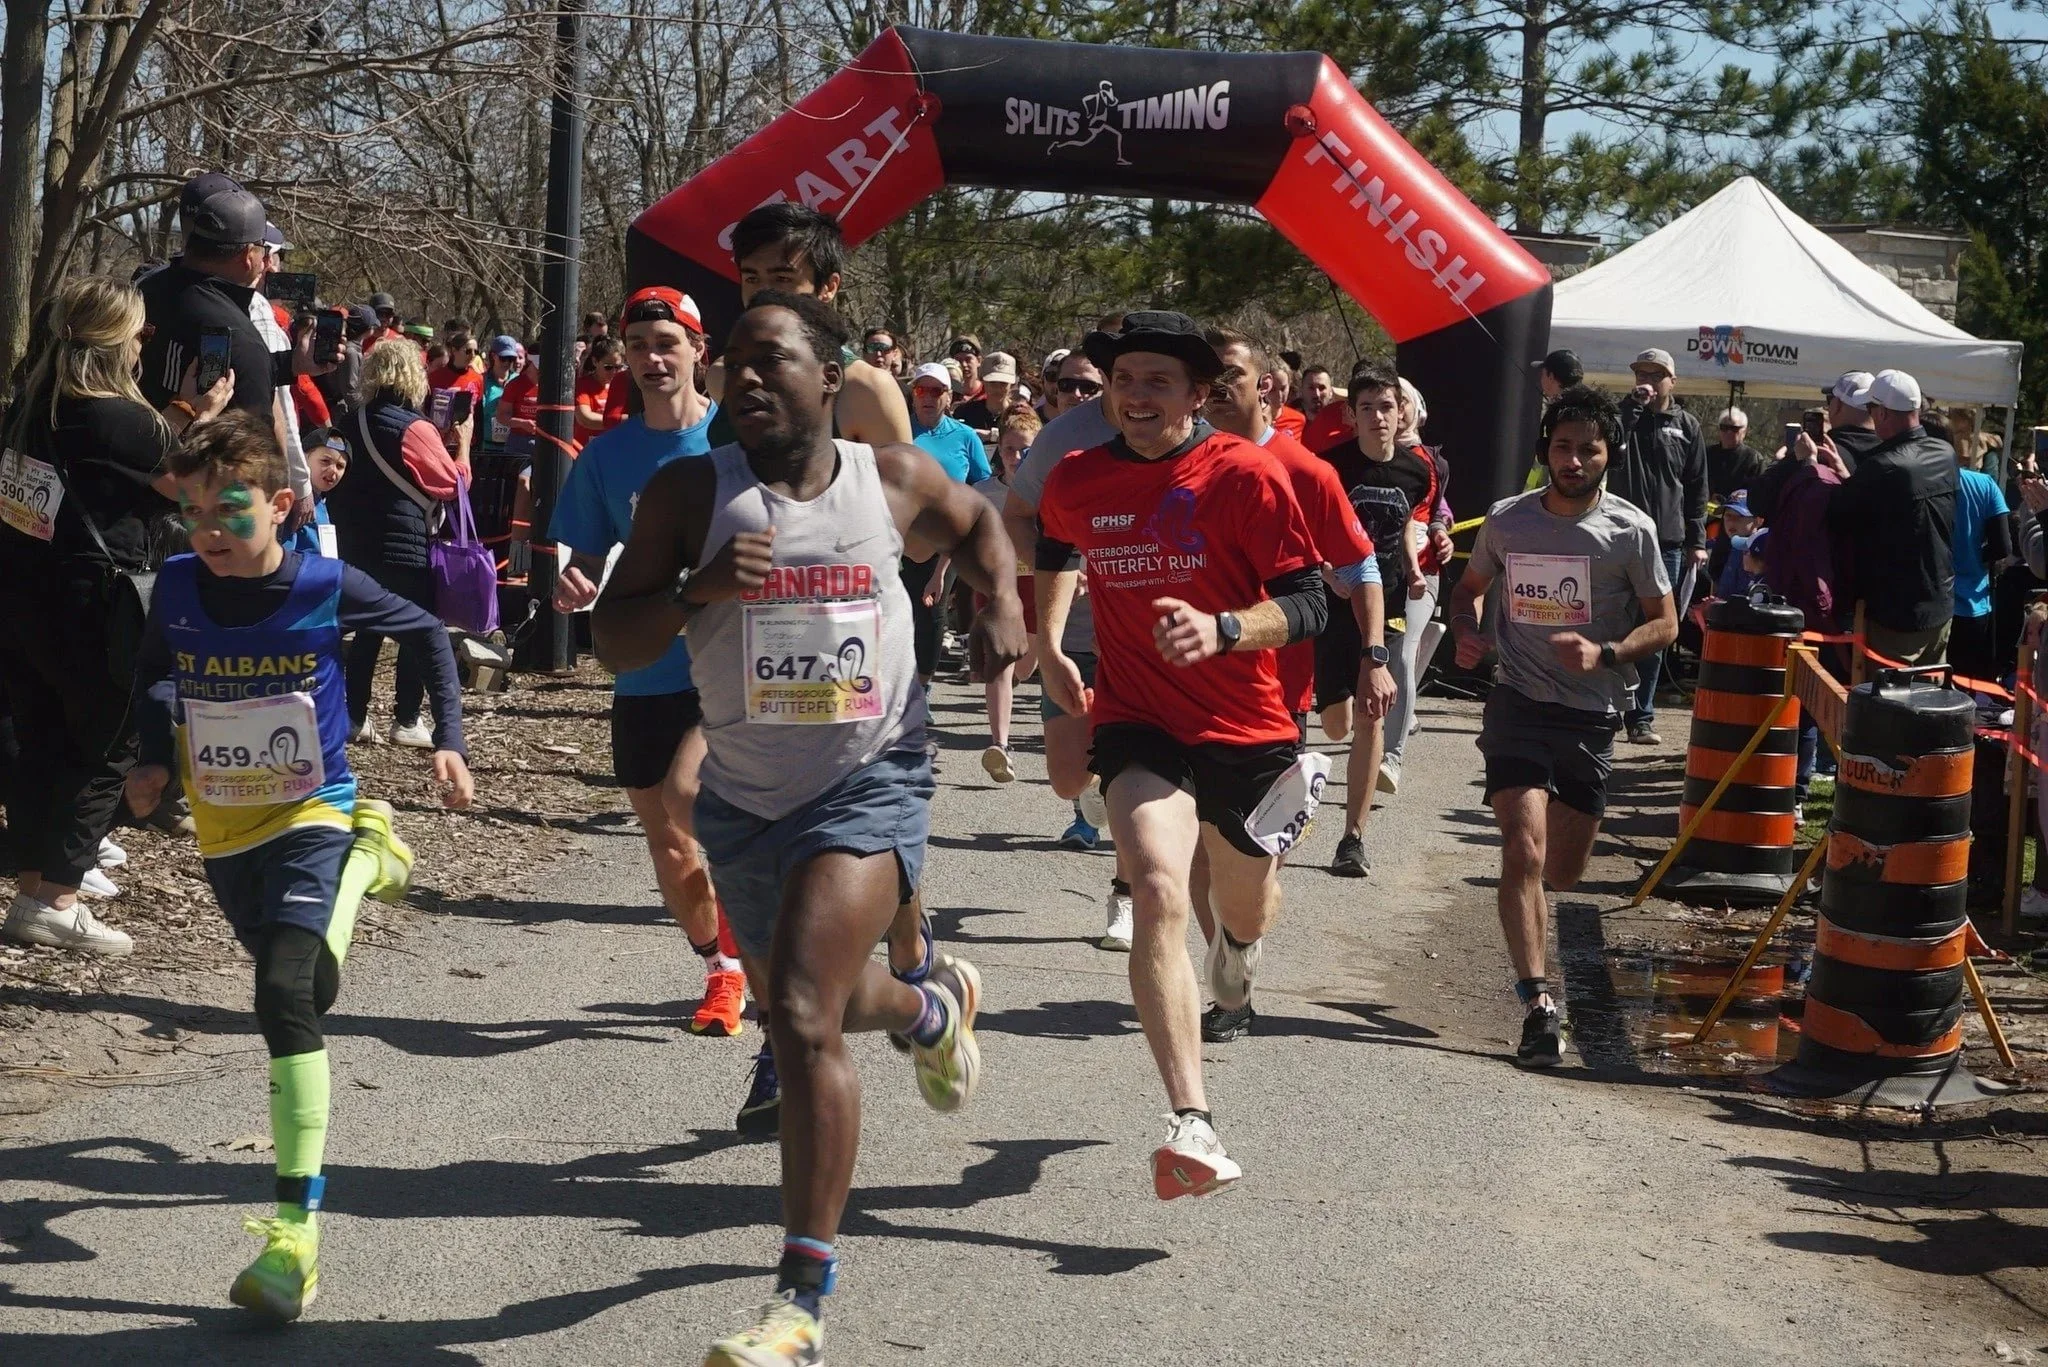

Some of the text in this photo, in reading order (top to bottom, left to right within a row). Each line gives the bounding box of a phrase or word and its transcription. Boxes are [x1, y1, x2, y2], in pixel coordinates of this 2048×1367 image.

[1005, 80, 1231, 136] SPLITS TIMING
[718, 106, 911, 262] ART
[1303, 130, 1487, 306] FINISH
[1746, 356, 1798, 366] PETERBOROUGH
[494, 426, 508, 434] 279
[0, 480, 24, 503] 390
[1091, 514, 1136, 528] GPHSF
[1088, 543, 1159, 559] PETERBOROUGH
[1090, 555, 1163, 576] UTTERFLY
[1168, 553, 1203, 570] RUN
[1148, 578, 1165, 586] WITH
[1514, 583, 1548, 600] 485
[1517, 609, 1584, 620] BUTTERFLY RUN
[176, 651, 317, 676] ST ALBANS
[755, 655, 818, 681] 647
[179, 678, 258, 699] ATHLETIC
[761, 689, 837, 699] PETERBOROUGH
[760, 696, 874, 714] BUTTERFLY RUN
[198, 745, 251, 767] 459
[204, 778, 313, 797] BUTTERFLY RUN
[1278, 810, 1310, 854] 428
